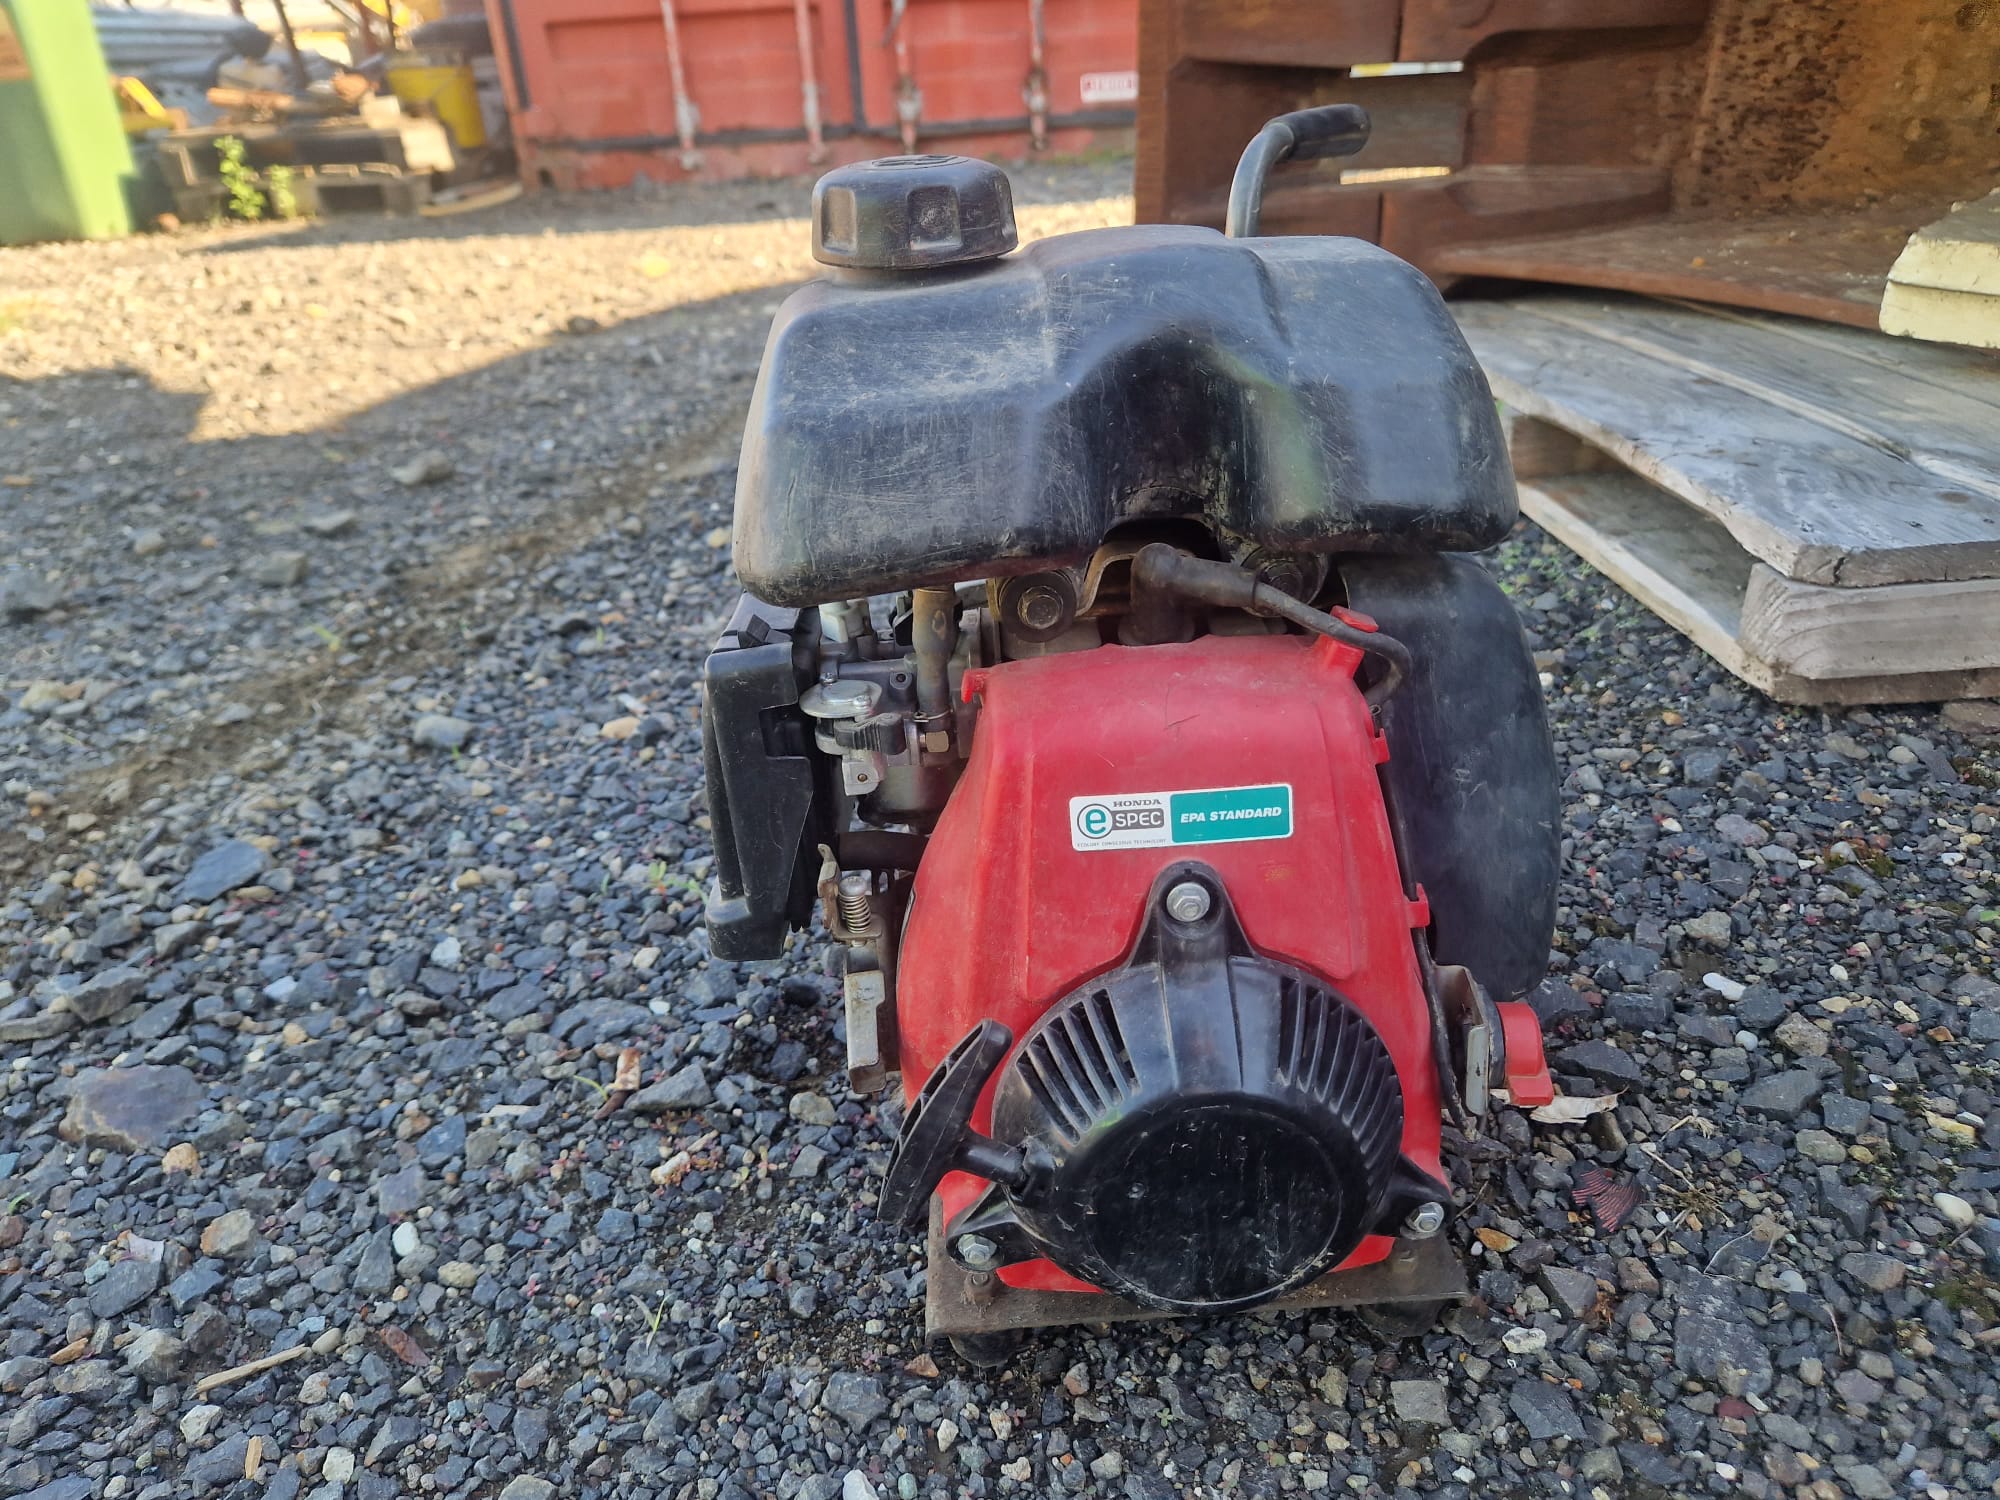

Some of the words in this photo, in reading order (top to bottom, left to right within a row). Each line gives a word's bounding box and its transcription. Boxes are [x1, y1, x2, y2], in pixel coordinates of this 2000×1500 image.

[1113, 799, 1162, 808] HONDA
[1085, 808, 1107, 835] e
[1115, 811, 1162, 827] SPEC
[1180, 812, 1206, 824] EPA
[1209, 806, 1282, 821] STANDARD
